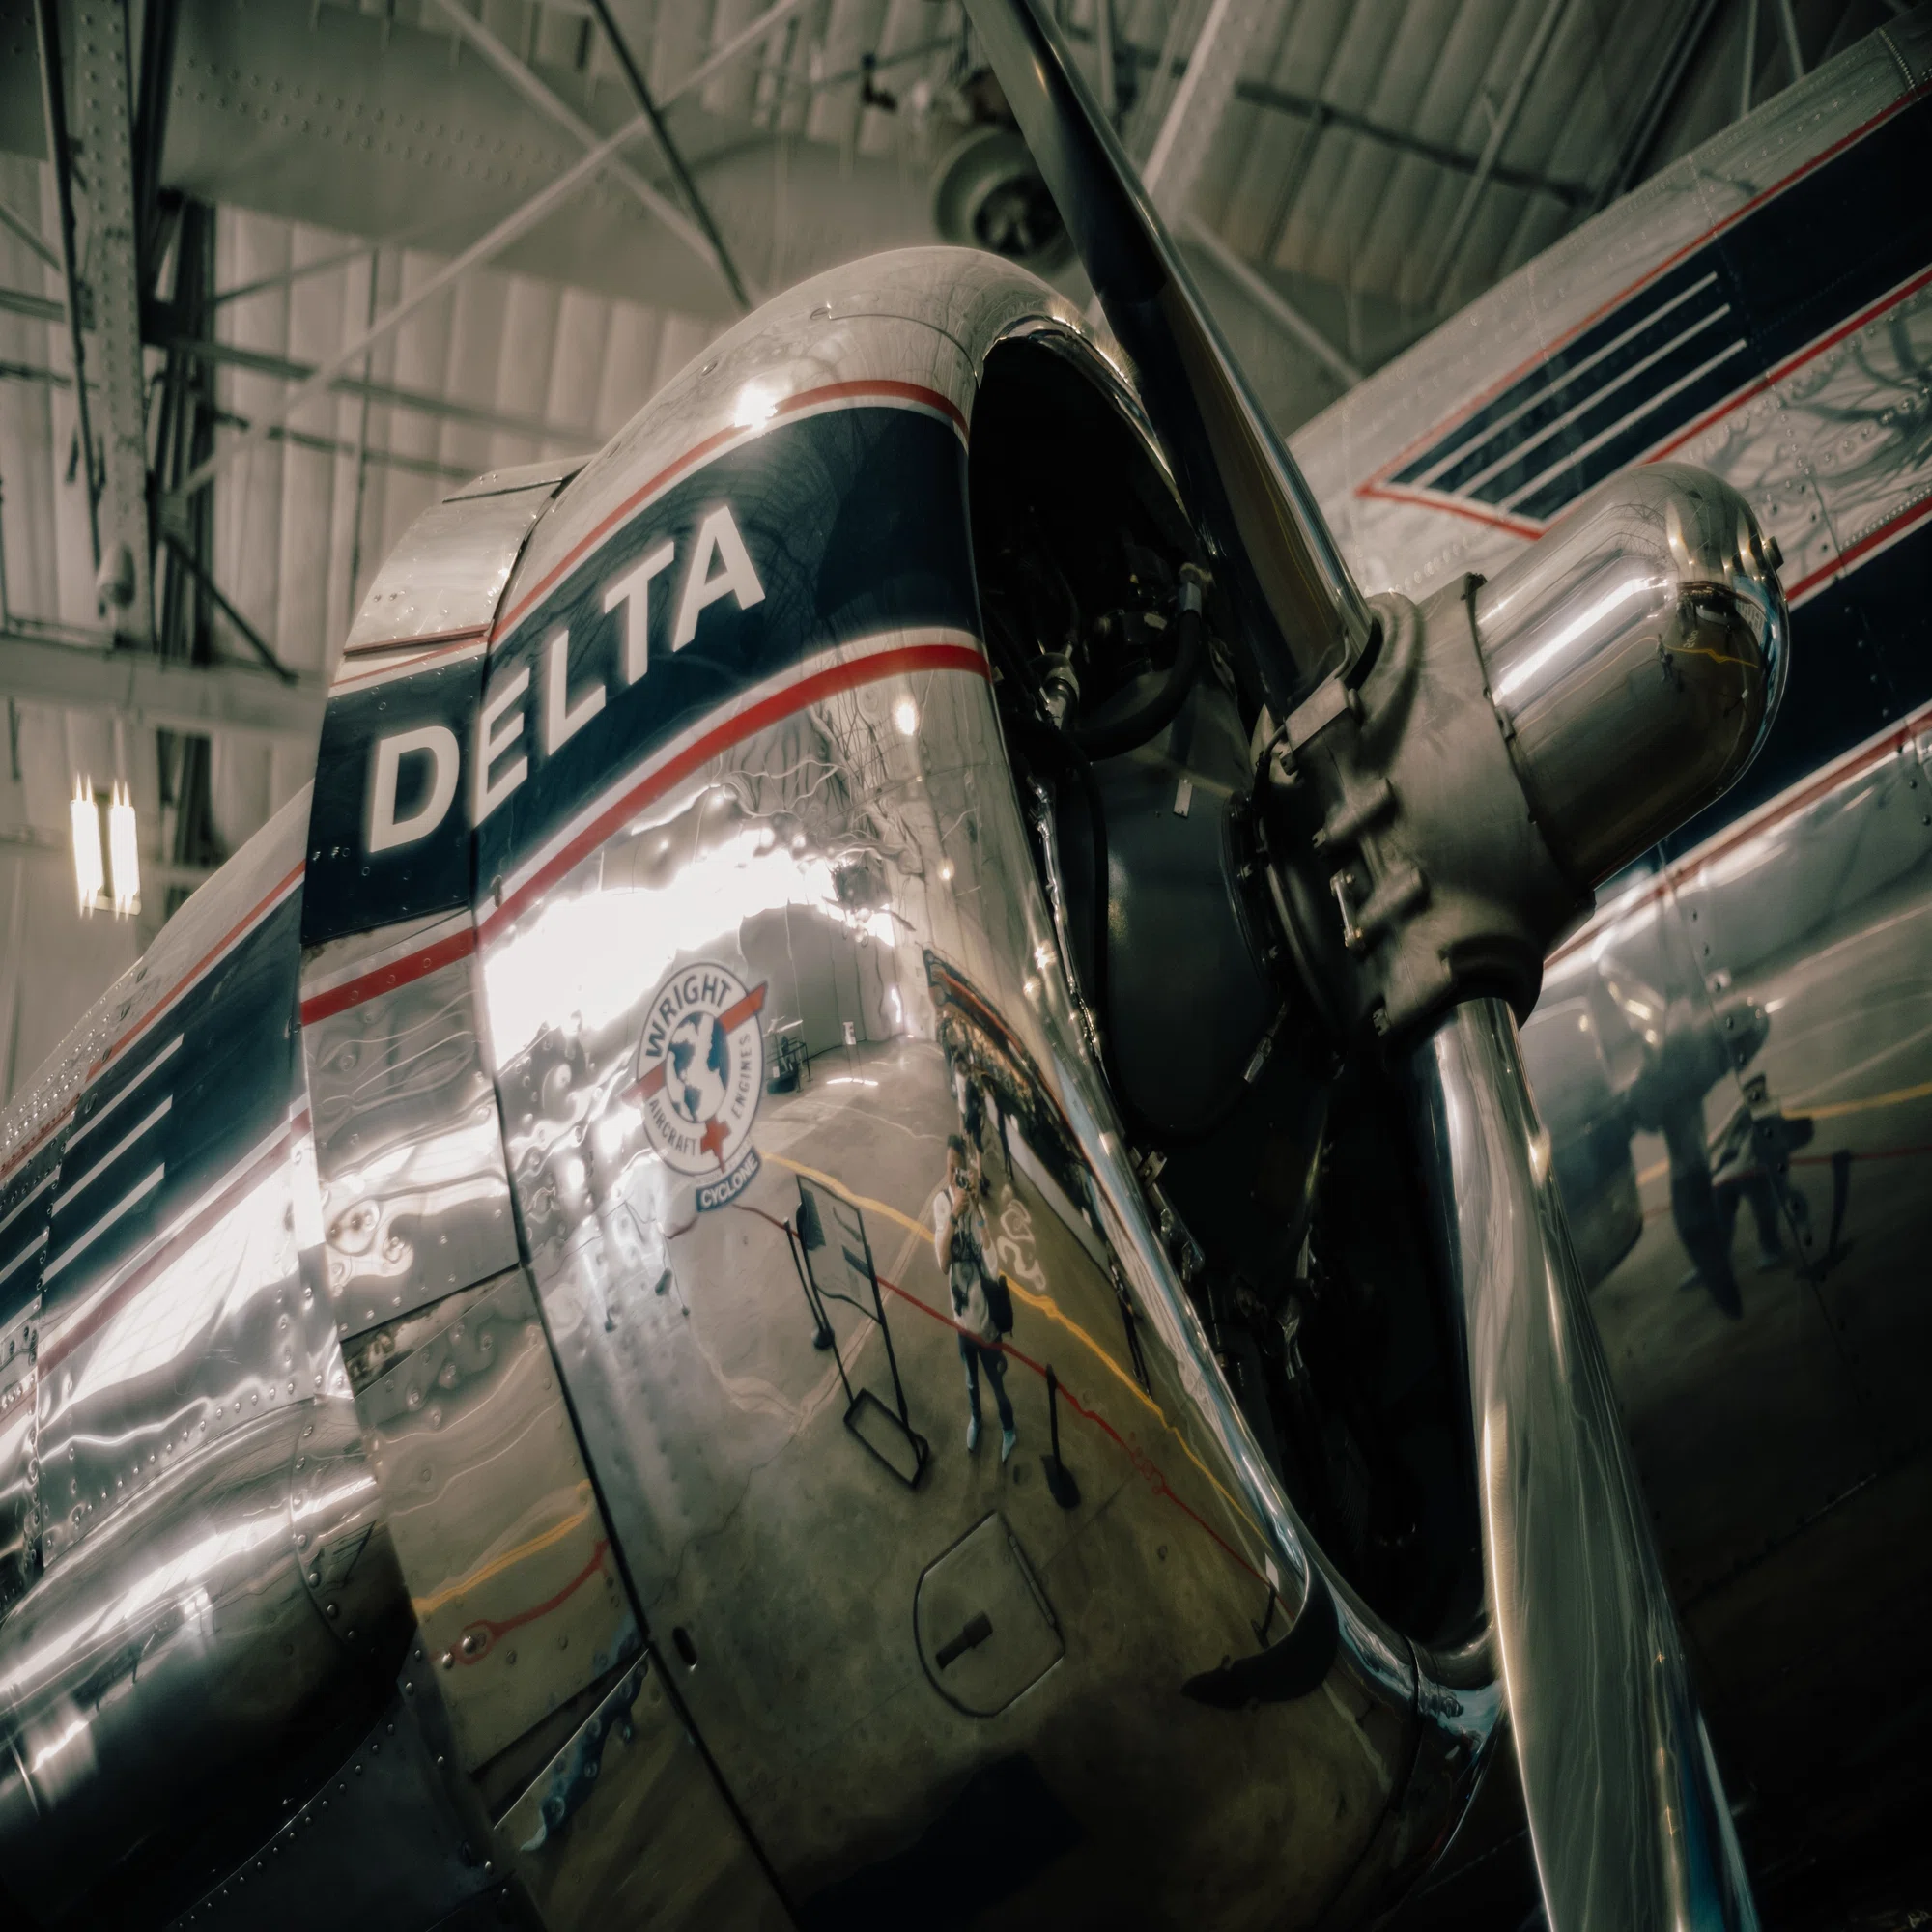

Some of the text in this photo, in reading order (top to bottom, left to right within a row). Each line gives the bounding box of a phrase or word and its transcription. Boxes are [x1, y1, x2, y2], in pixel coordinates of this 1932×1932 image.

[369, 506, 766, 853] DELTA
[645, 973, 732, 1059] WRIGHT
[732, 1032, 753, 1120] ENGINES
[648, 1098, 697, 1157] AIRCRAFT
[700, 1154, 759, 1208] CYCLONE
